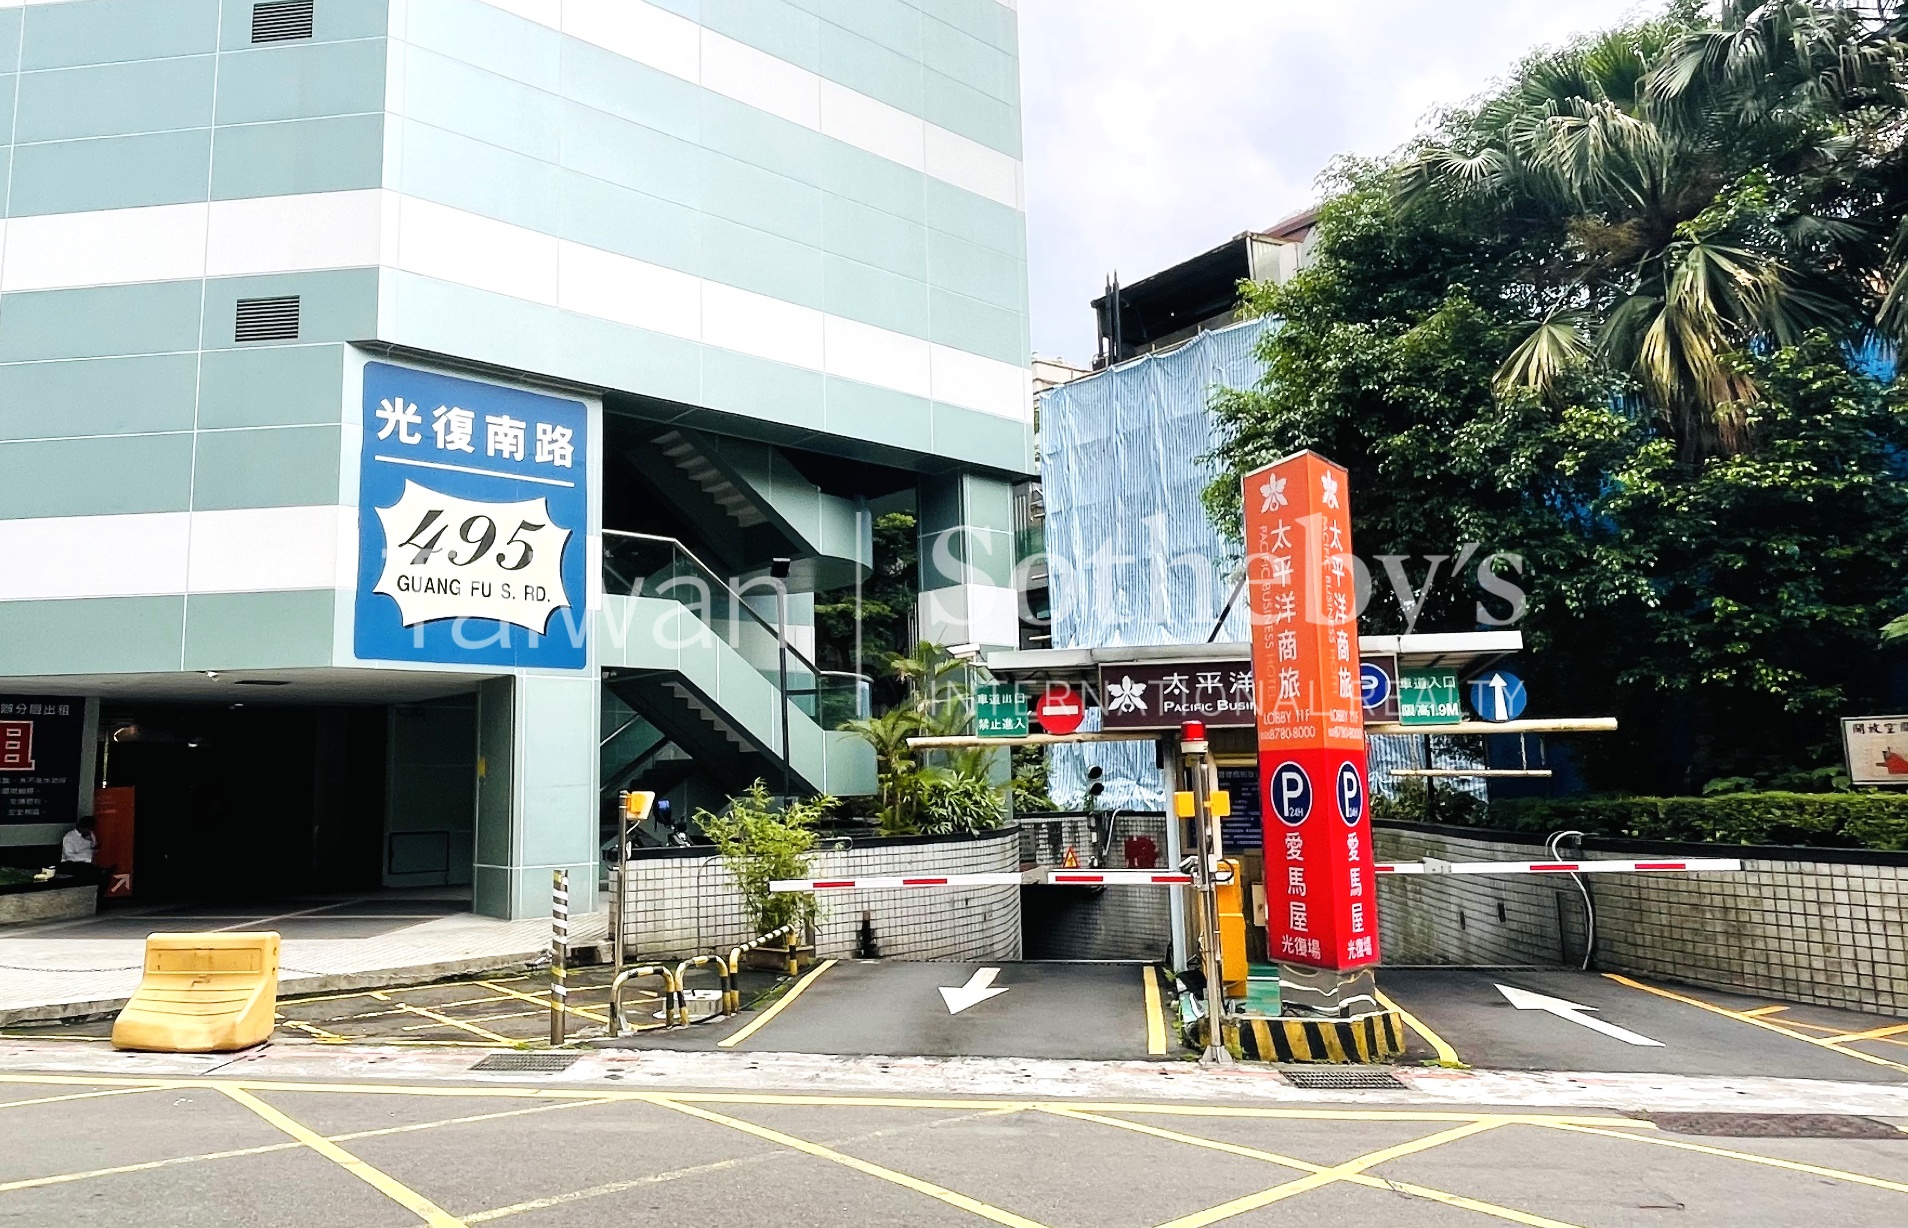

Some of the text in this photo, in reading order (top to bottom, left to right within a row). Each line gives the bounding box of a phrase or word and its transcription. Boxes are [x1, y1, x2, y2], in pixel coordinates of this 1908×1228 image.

[375, 396, 575, 469] 光復南路
[398, 509, 546, 571] 495
[1259, 525, 1271, 578] PACIFIC
[396, 574, 550, 603] GUANG FU S. RD.
[1261, 582, 1275, 650] BUSINESS
[1271, 518, 1302, 700] 太平洋商旅
[1329, 519, 1353, 699] 太平洋商旅
[977, 693, 1025, 705] 車道出口
[1162, 671, 1253, 695] 太平洋
[1399, 675, 1456, 689] 車道入口
[978, 717, 1026, 730] 禁止進入
[1163, 701, 1213, 712] PACIFIC
[1263, 710, 1291, 725] LOBBY
[1401, 703, 1459, 717] 限高1.9M
[1282, 772, 1303, 817] P
[1289, 807, 1303, 817] 24H
[1343, 771, 1357, 817] P
[1285, 831, 1309, 932] 愛馬屋
[1347, 831, 1364, 933] 愛馬屋
[1281, 934, 1321, 960] 光復場
